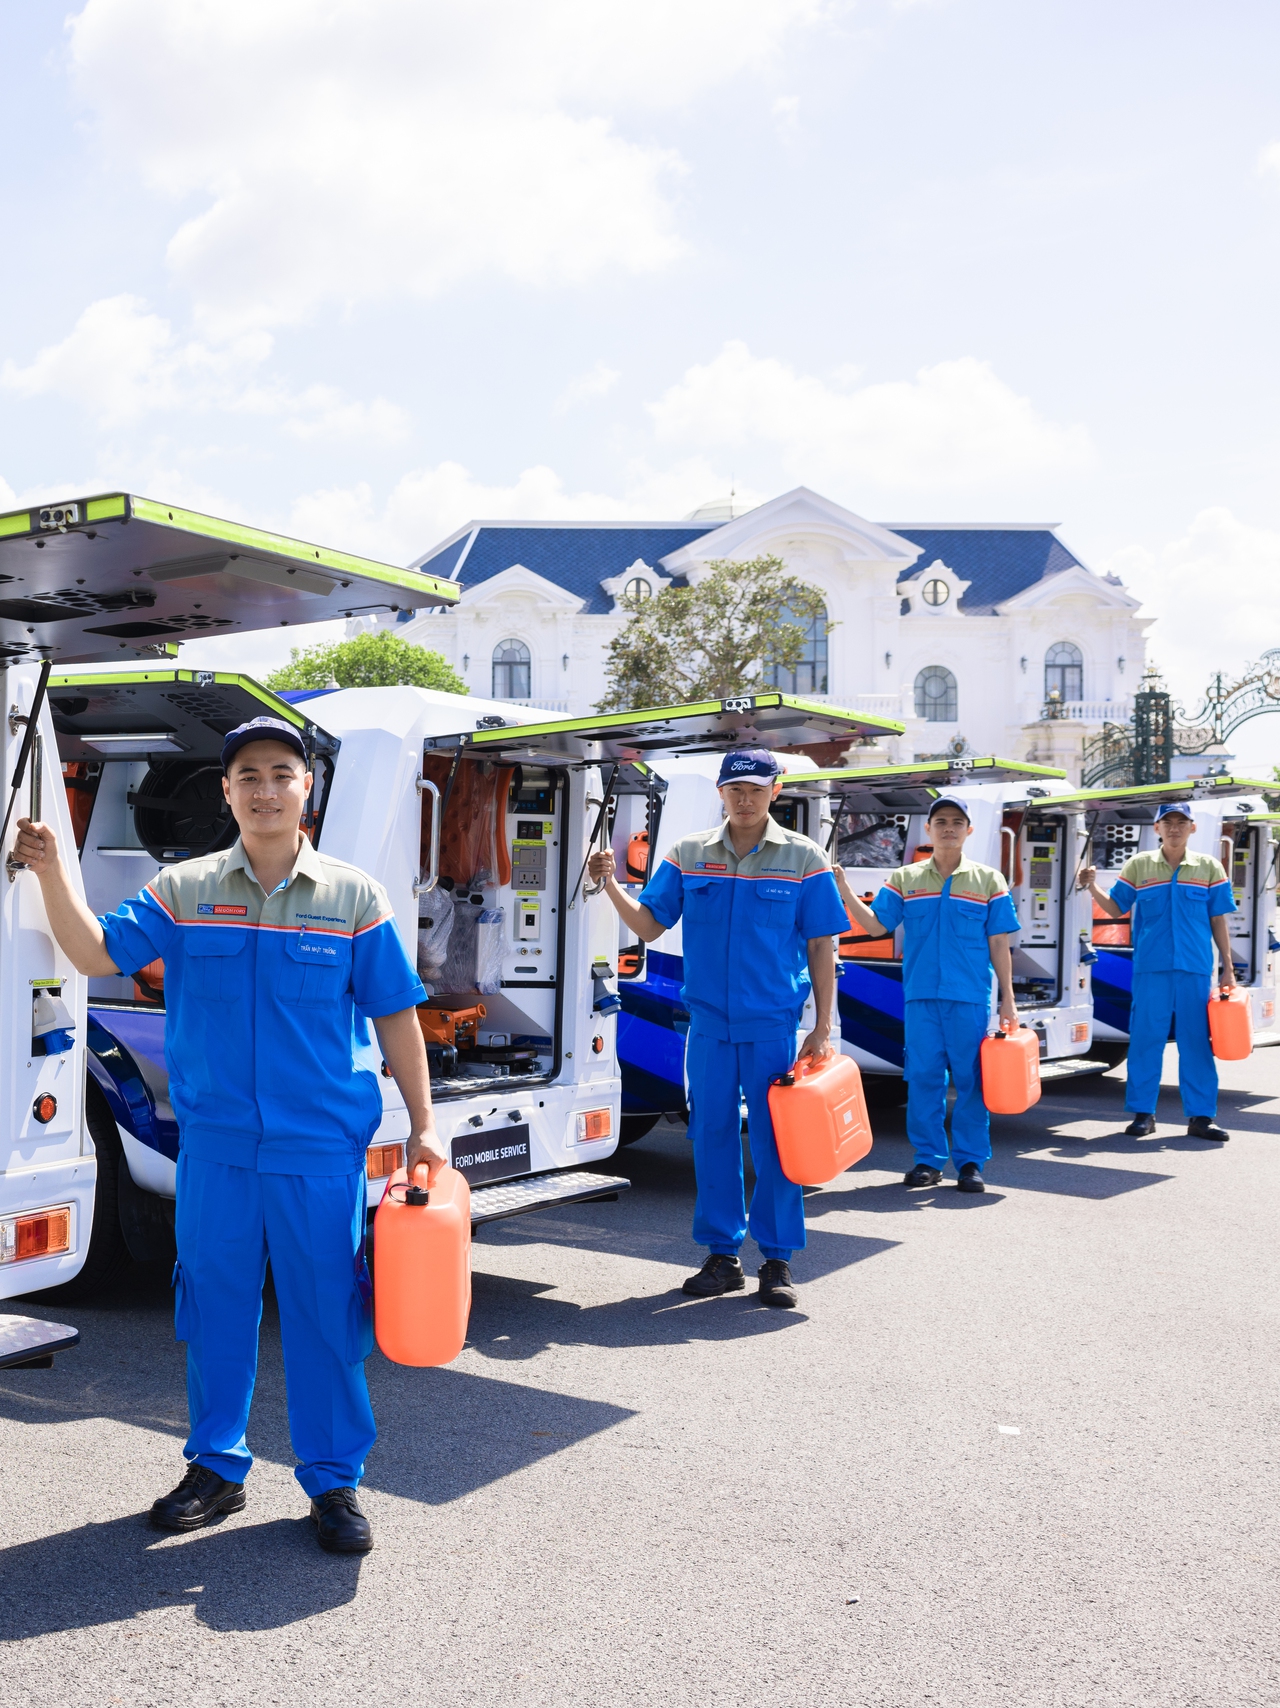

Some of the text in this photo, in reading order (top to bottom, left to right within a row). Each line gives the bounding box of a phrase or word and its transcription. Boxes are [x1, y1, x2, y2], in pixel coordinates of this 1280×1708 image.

[731, 760, 757, 771] Ford
[322, 916, 346, 924] Experience
[455, 1143, 527, 1168] FORD MOBILE SERVICE
